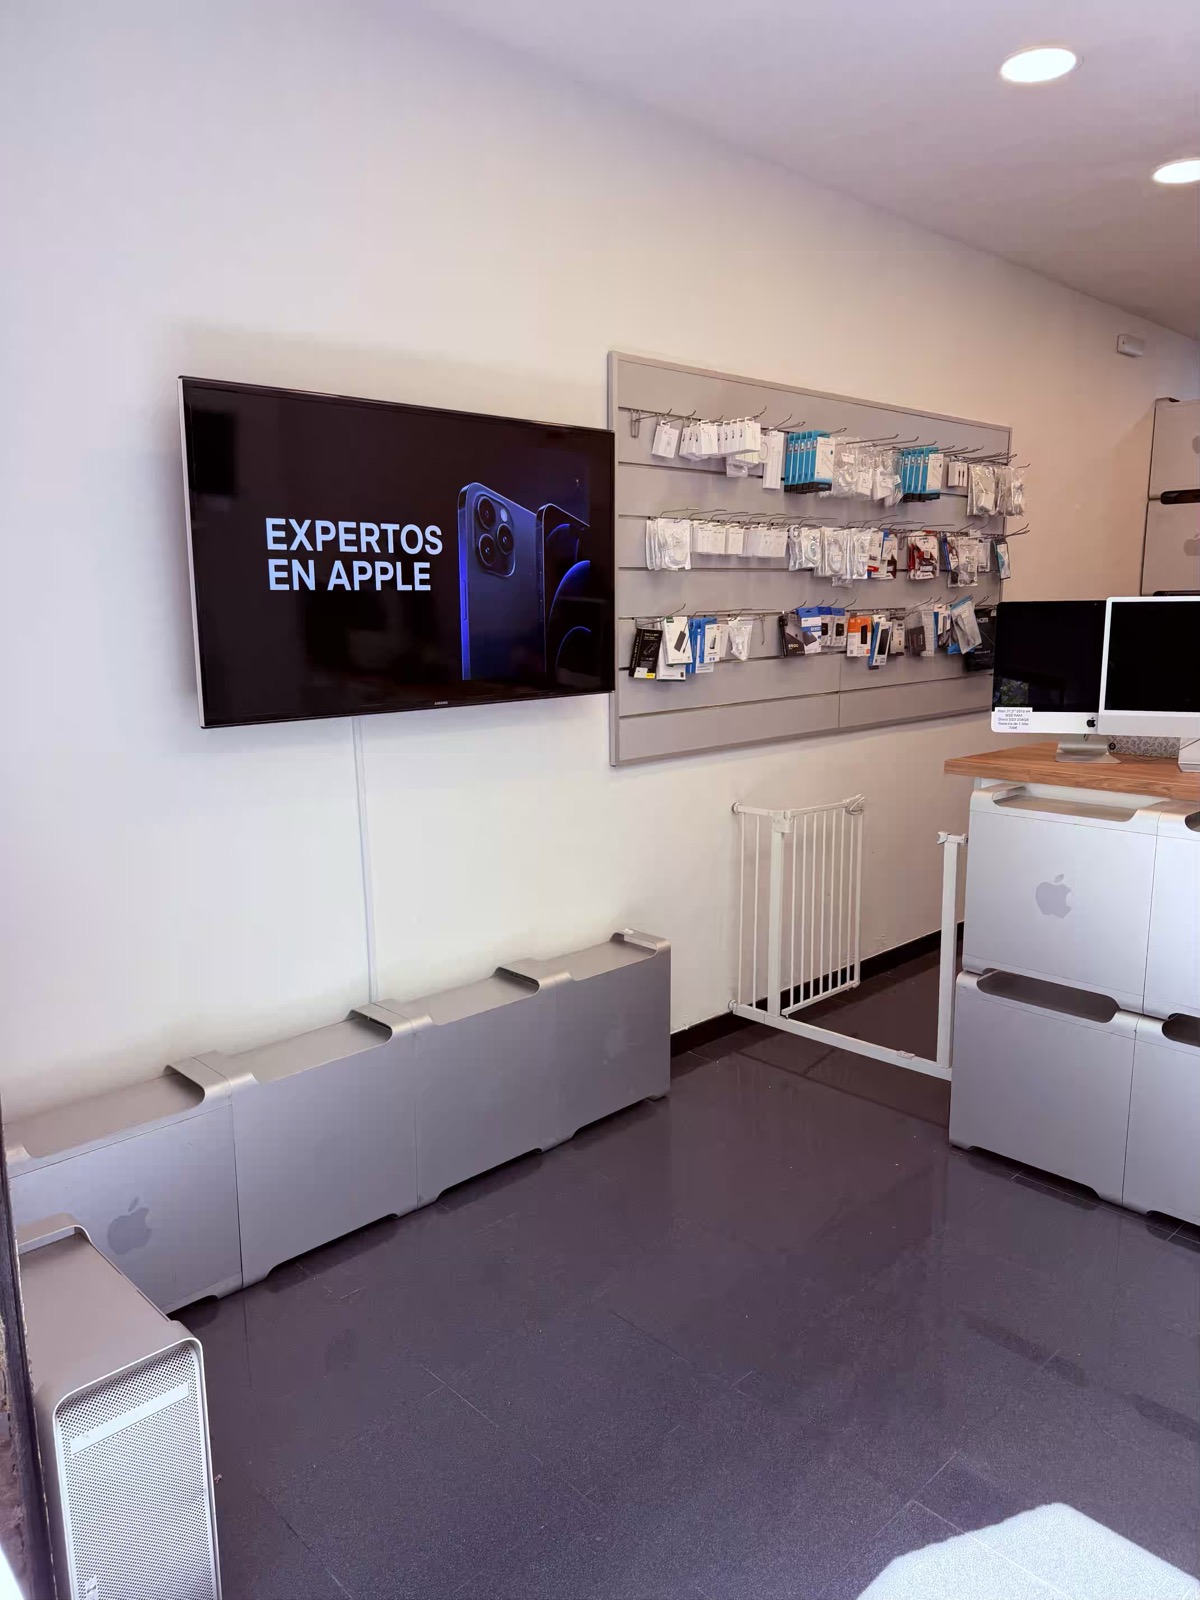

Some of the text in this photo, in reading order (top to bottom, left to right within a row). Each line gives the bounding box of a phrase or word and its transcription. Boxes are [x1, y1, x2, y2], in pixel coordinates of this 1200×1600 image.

[265, 517, 443, 555] EXPERTOS
[267, 558, 432, 591] EN APPLE
